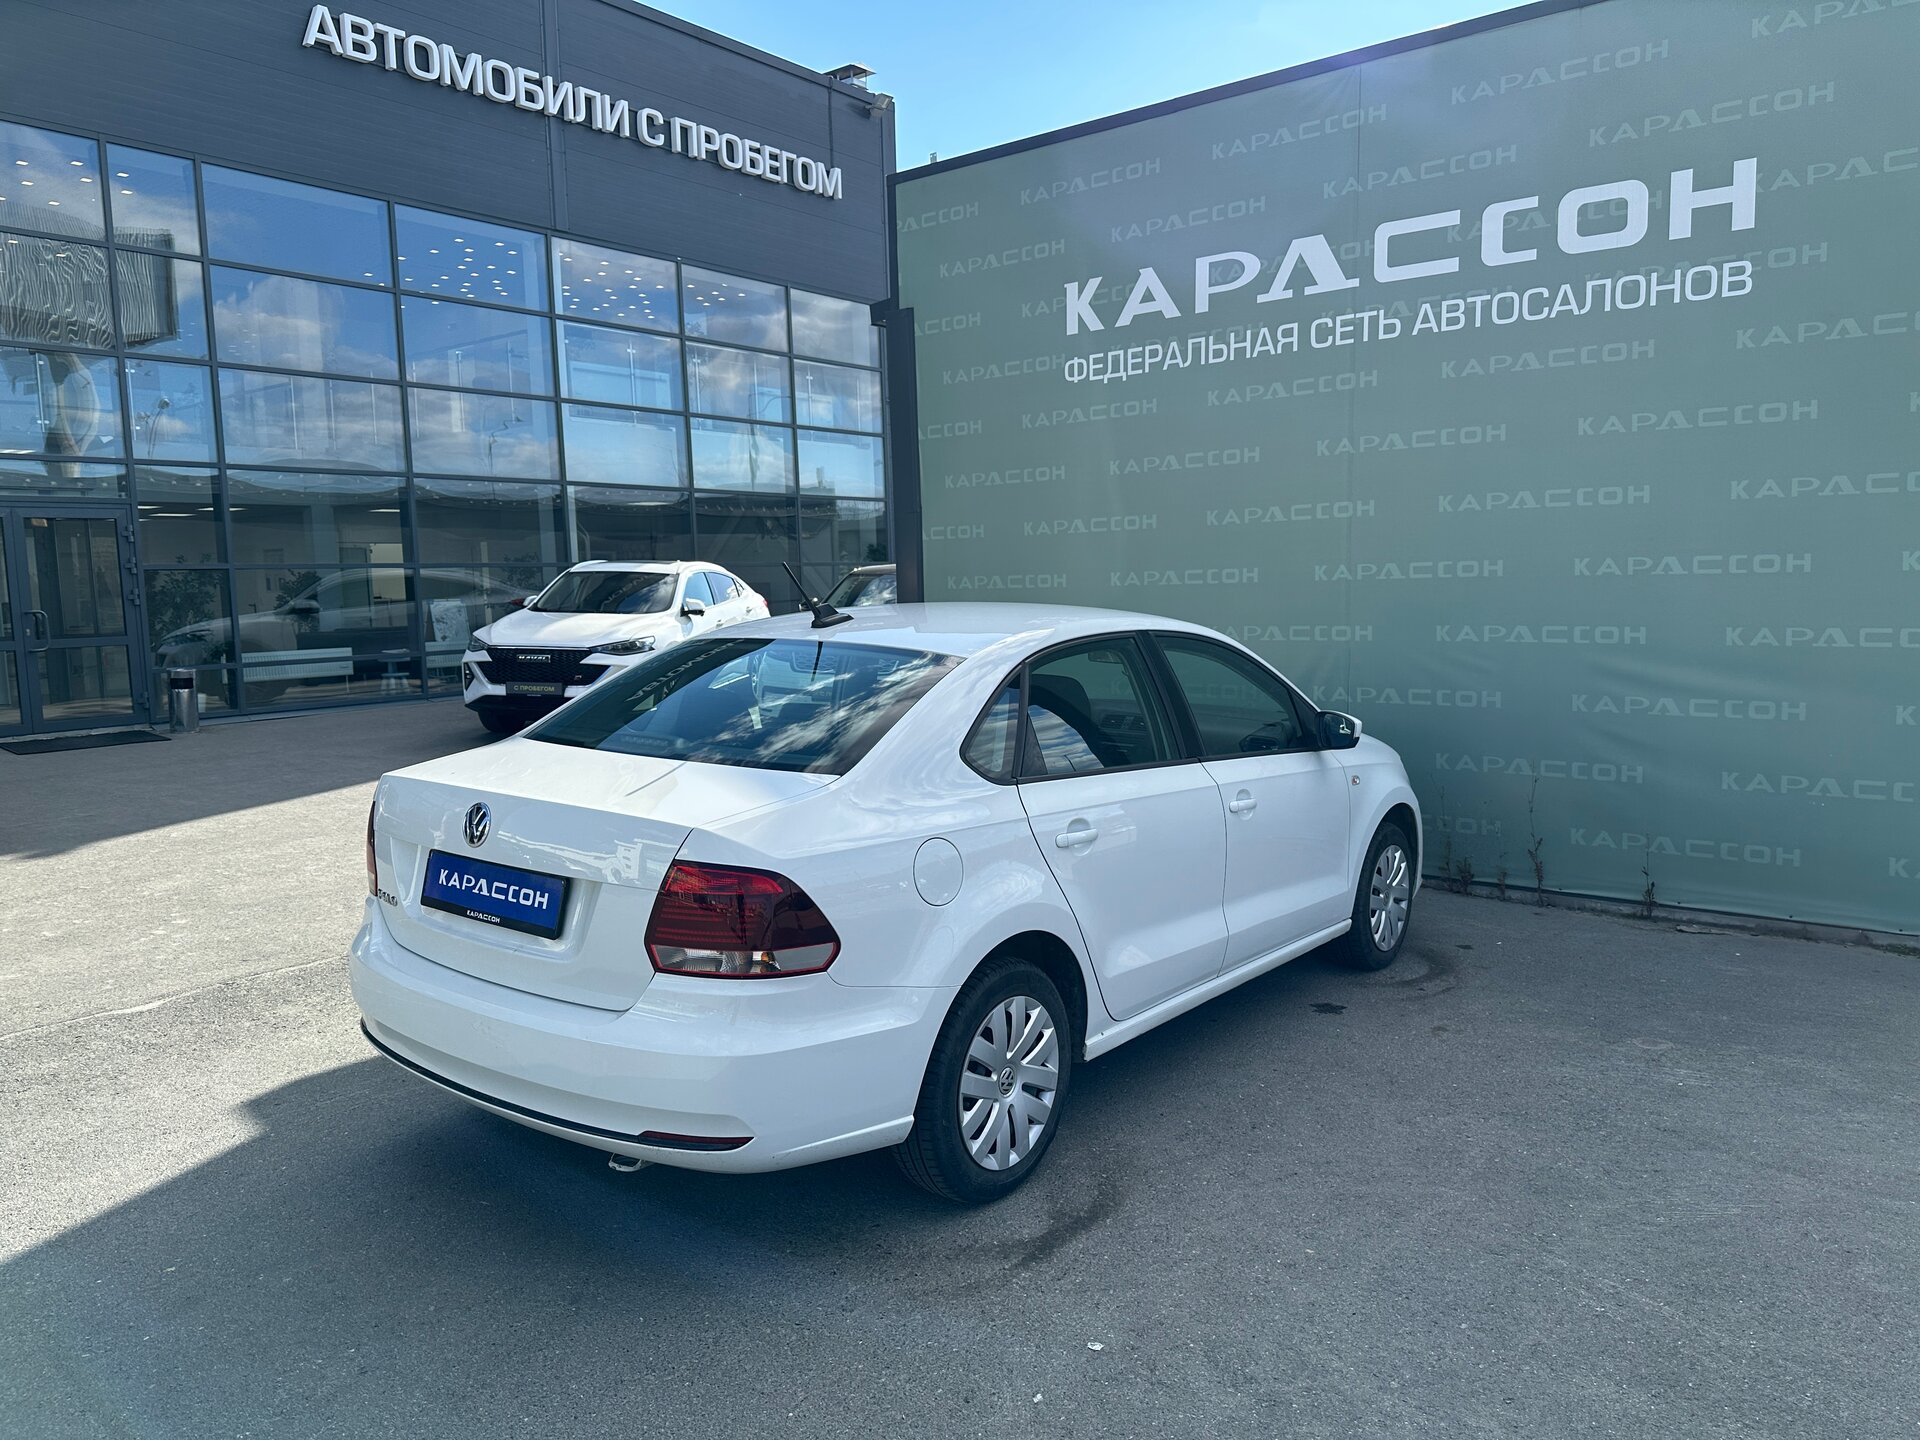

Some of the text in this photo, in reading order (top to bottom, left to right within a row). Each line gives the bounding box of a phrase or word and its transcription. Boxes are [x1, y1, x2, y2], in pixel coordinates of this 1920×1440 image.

[1451, 39, 1669, 104] КАРАССОН
[302, 4, 842, 199] АВТОМОБИЛИ С ПРОБЕГОМ
[1589, 82, 1835, 147] КАРАССОН
[1212, 104, 1387, 160] КАРАССОН
[1020, 158, 1161, 205] КАРАССОН
[1323, 144, 1517, 199] КАРАССОН
[1111, 196, 1266, 243] КАРАССОН
[939, 240, 1065, 278] КАРАССОН
[1064, 157, 1758, 336] КАРАССОН
[1064, 260, 1753, 384] ФЕДЕРАЛЬНАЯ СЕТЬ АВТОСАЛОНОВ
[943, 353, 1066, 385] КАРАССОН
[1441, 339, 1655, 379] КАРАССОН
[1207, 370, 1378, 406] КАРАССОН
[1022, 399, 1157, 429] КАРАССОН
[1578, 400, 1819, 435] КАРАССОН
[1316, 424, 1506, 457] КАРАССОН
[945, 465, 1065, 488] КАРАССОН
[1109, 447, 1260, 476] КАРАССОН
[1207, 500, 1375, 526] КАРАССОН
[1438, 485, 1650, 512] КАРАССОН
[1024, 514, 1157, 536] КАРАССОН
[947, 573, 1067, 589] КАРАССОН
[1110, 567, 1259, 587] КАРАССОН
[1315, 560, 1503, 581] КАРАССОН
[1574, 553, 1812, 576] КАРАССОН
[1436, 625, 1647, 645] КАРАССОН
[1314, 685, 1502, 708] КАРАССОН
[1571, 694, 1807, 721] КАРАССОН
[1436, 753, 1643, 784] КАРАССОН
[1570, 828, 1802, 867] КАРАССОН
[438, 869, 548, 909] КАРАССОН
